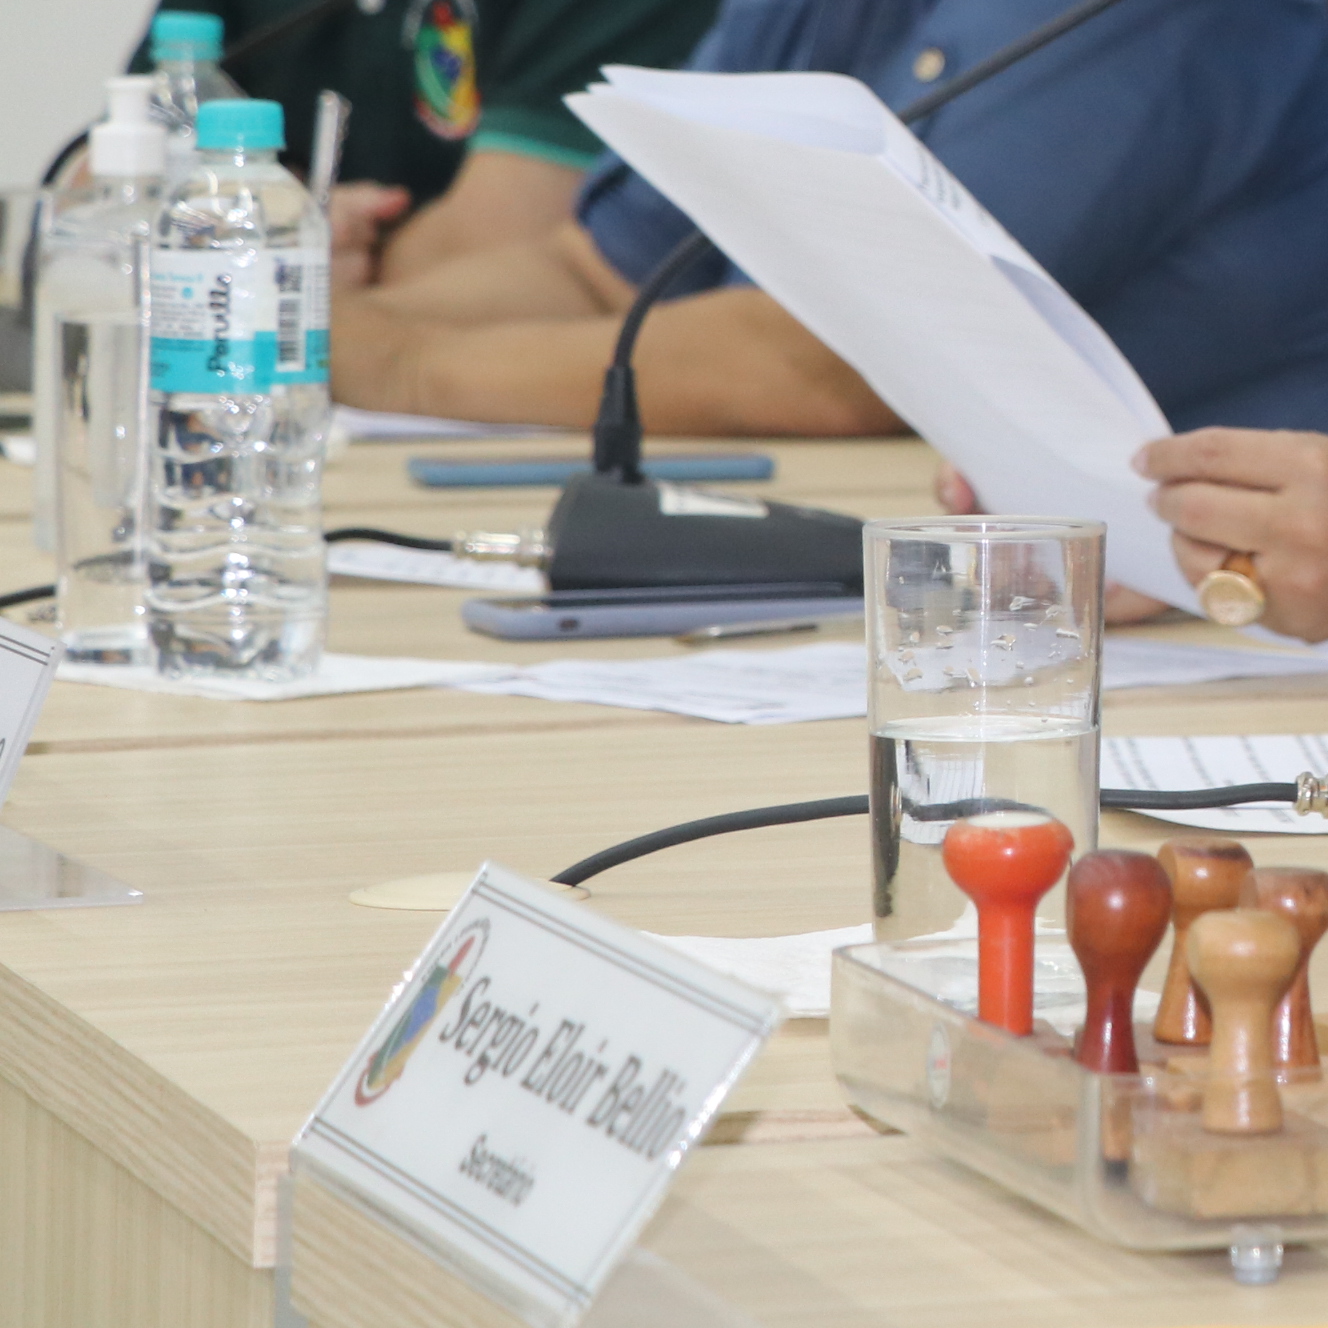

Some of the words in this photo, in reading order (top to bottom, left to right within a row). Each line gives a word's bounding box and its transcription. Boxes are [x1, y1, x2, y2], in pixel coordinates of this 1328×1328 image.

[438, 975, 541, 1086] Sergio
[519, 1017, 609, 1115] Eloir
[585, 1053, 687, 1161] Bellio
